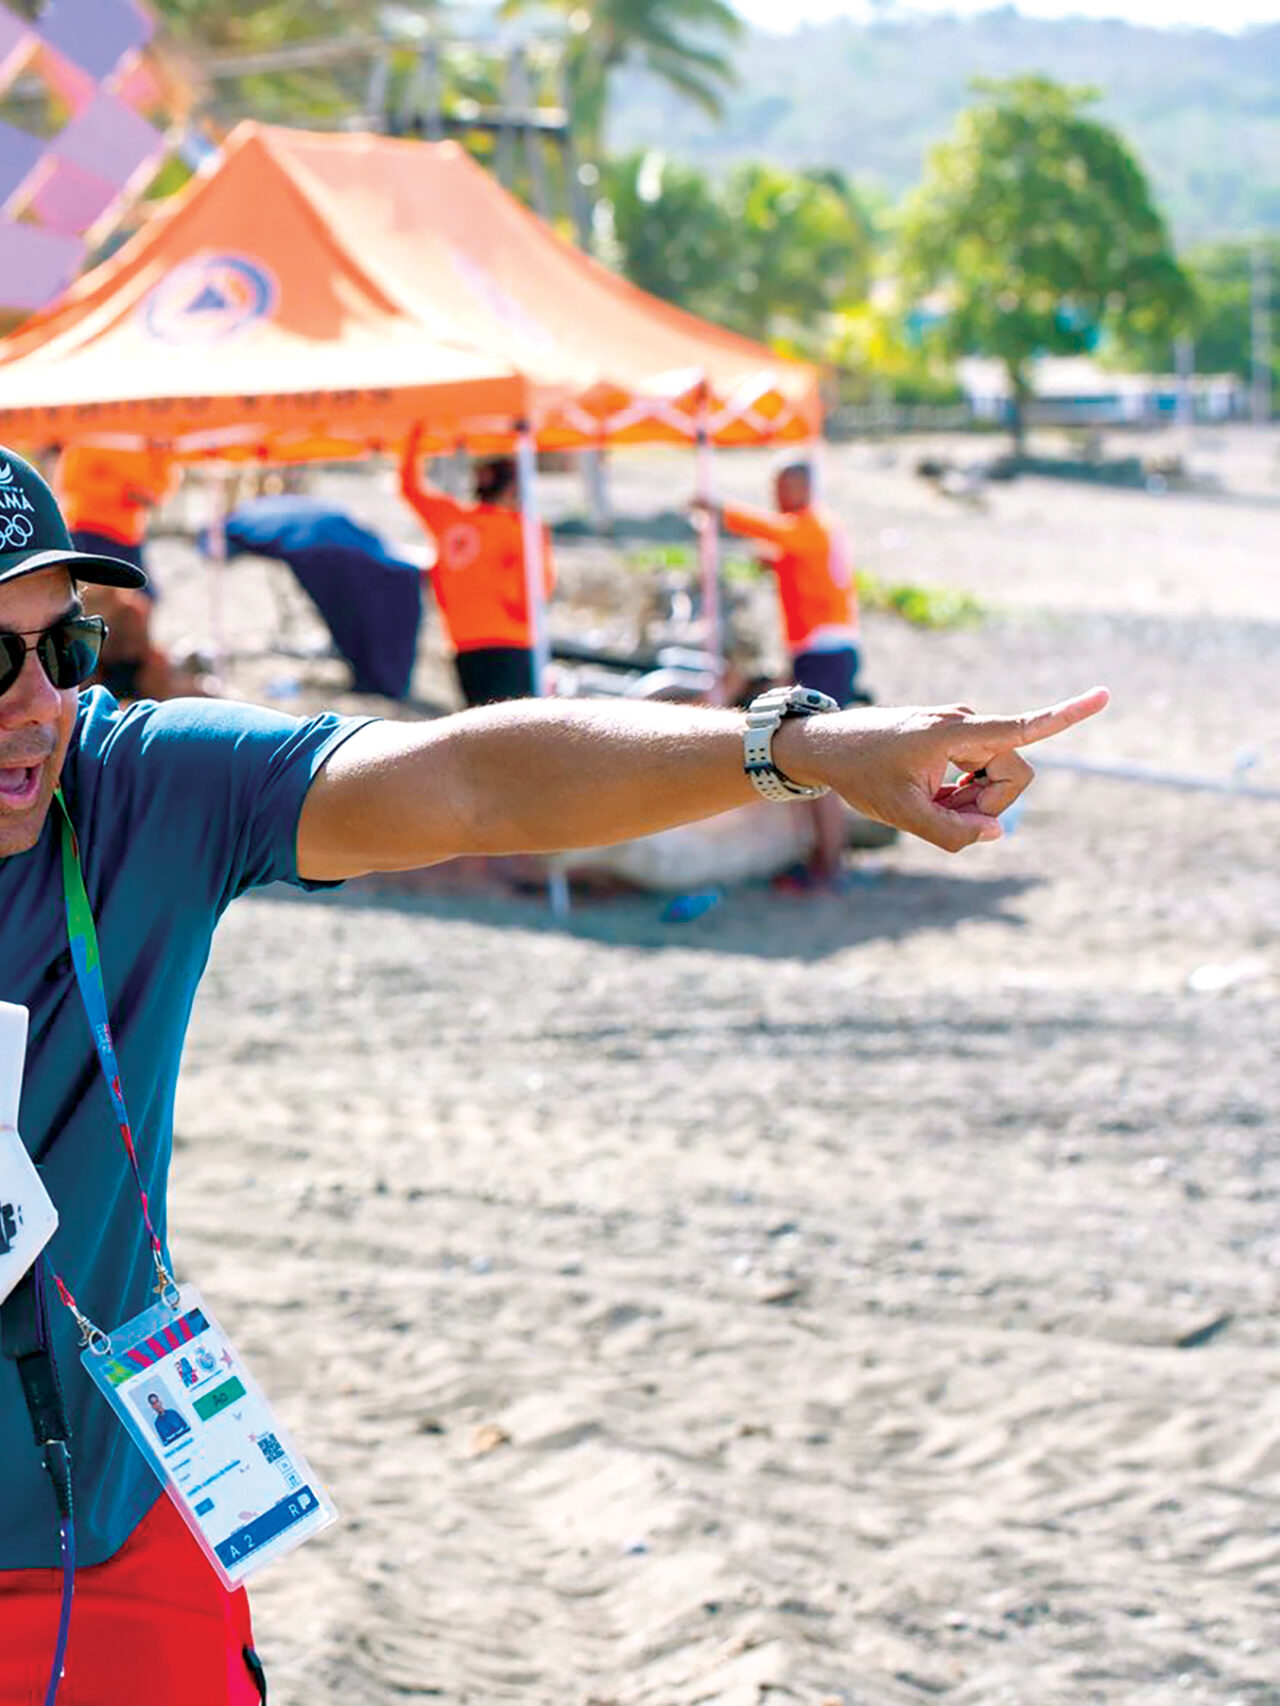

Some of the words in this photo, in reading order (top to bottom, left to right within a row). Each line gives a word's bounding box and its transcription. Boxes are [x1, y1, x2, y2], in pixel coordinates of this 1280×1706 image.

[229, 1544, 241, 1560] A
[243, 1536, 256, 1549] 2
[288, 1503, 301, 1517] R
